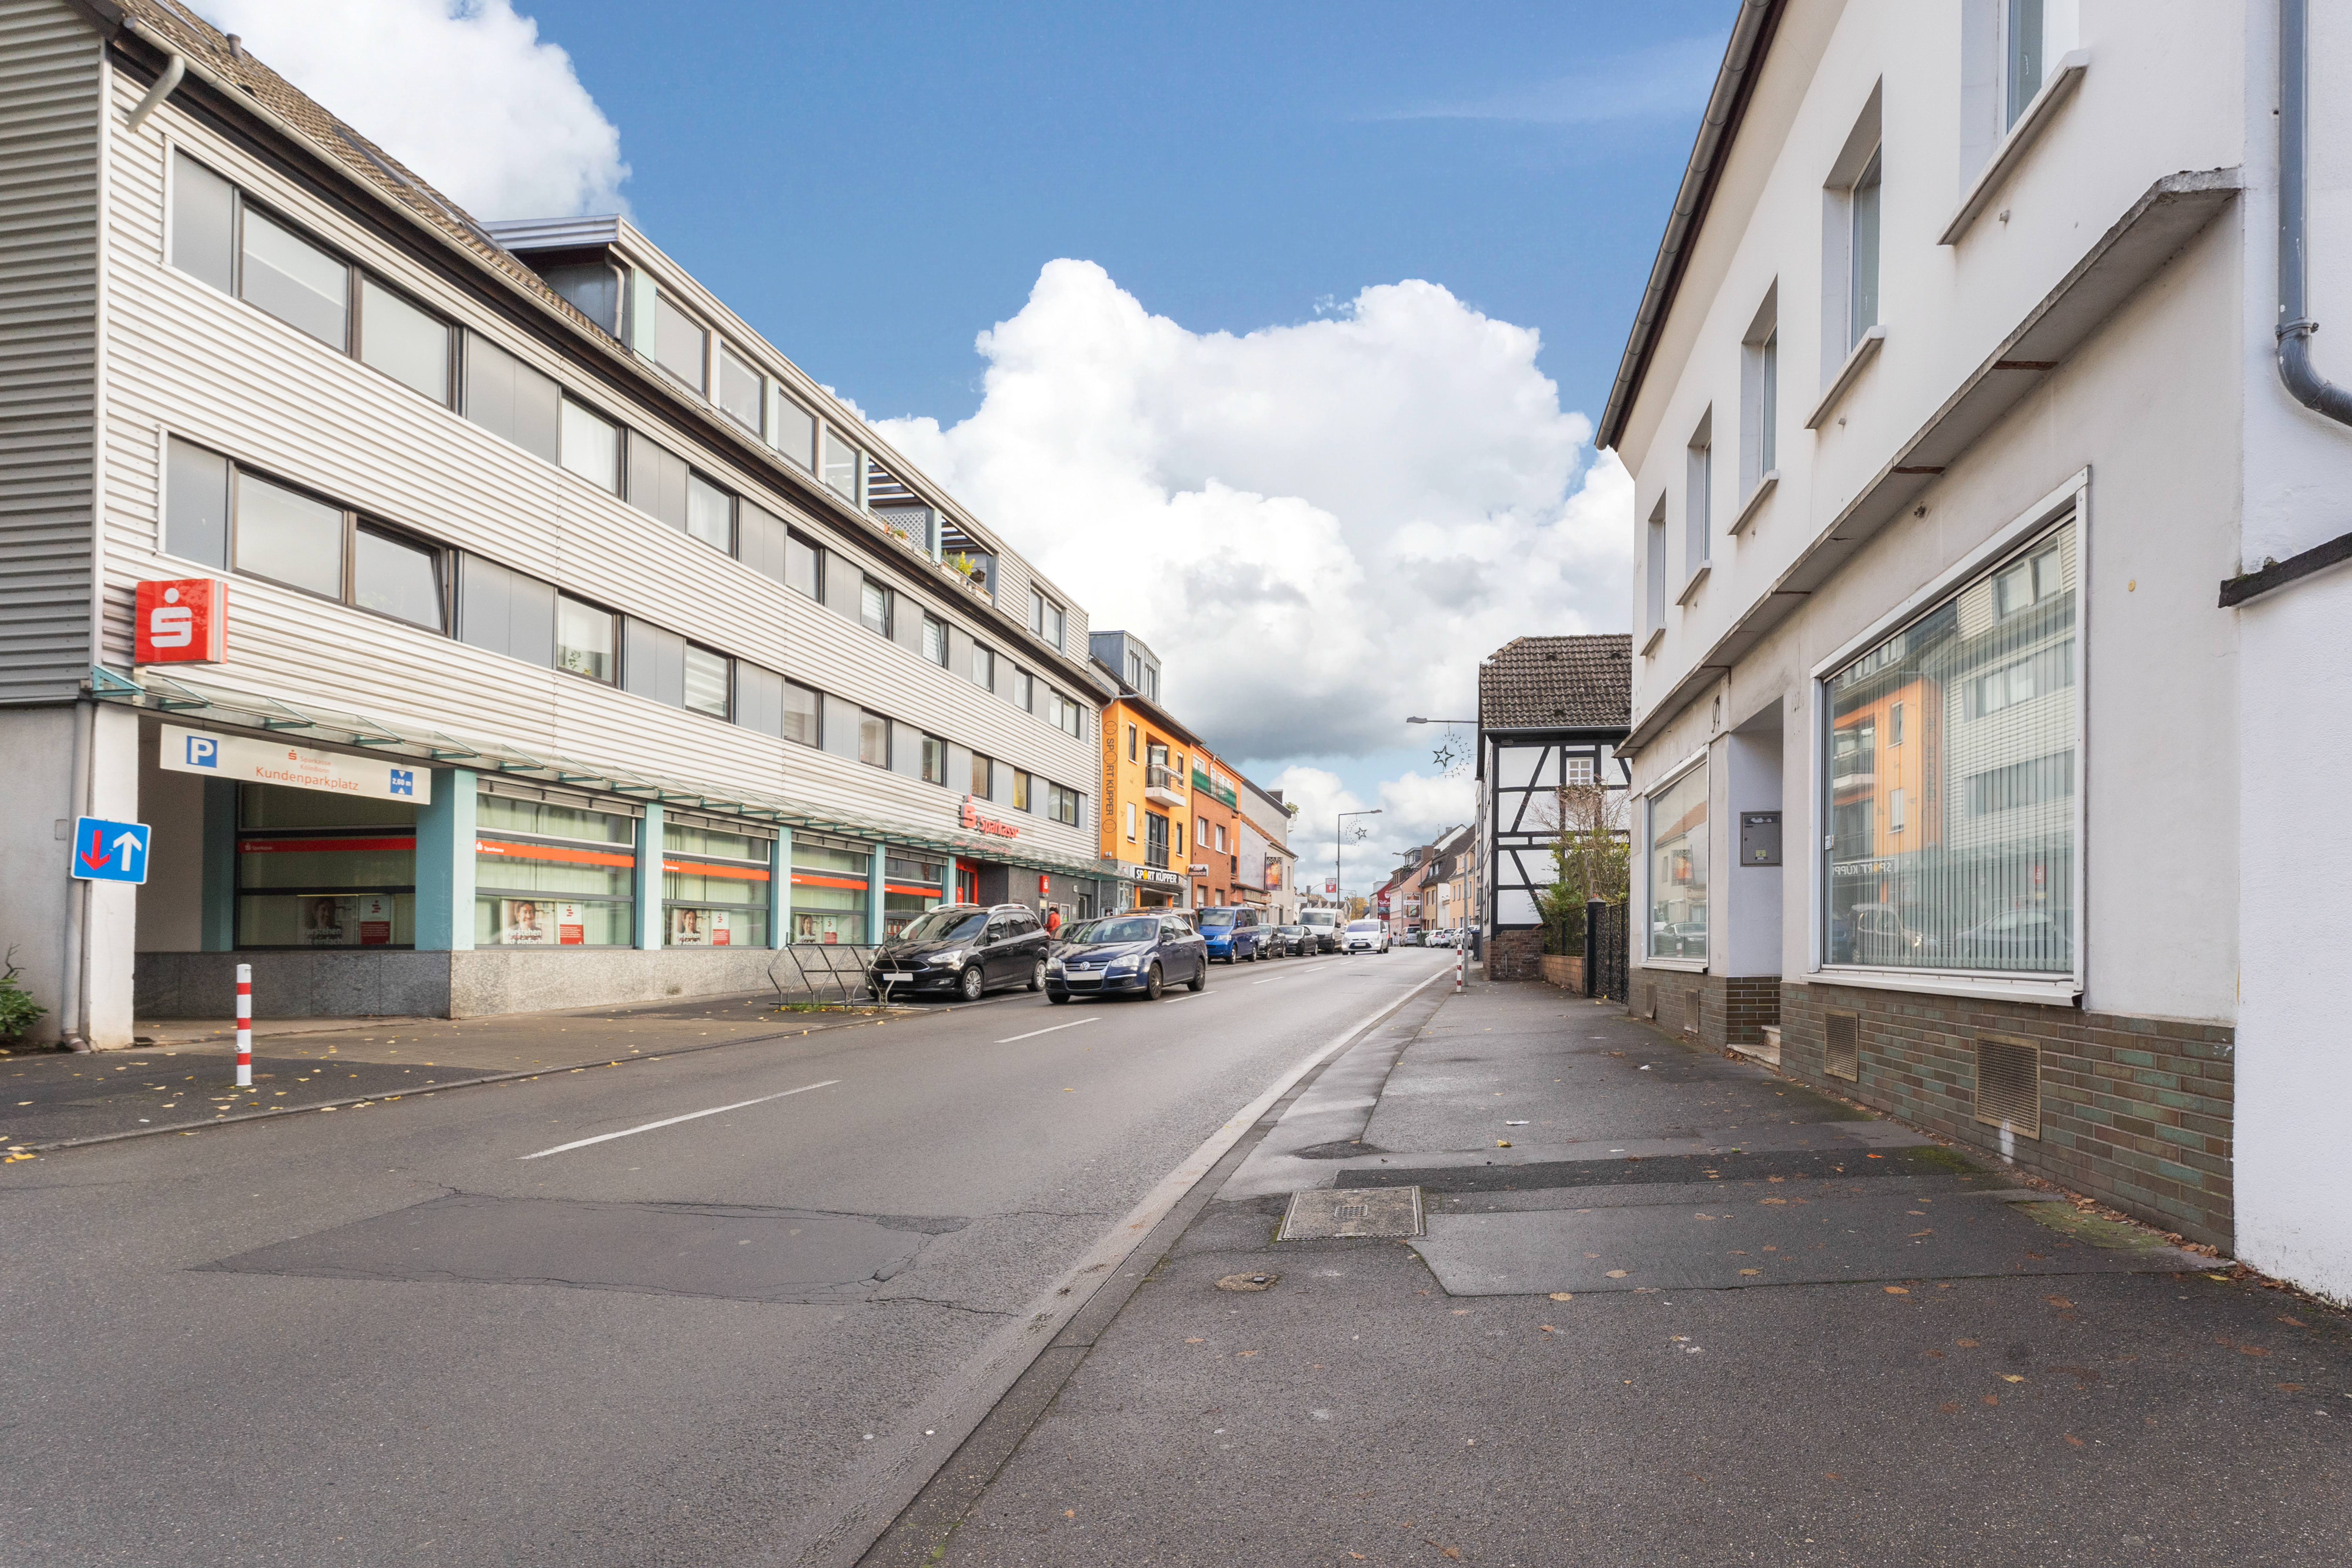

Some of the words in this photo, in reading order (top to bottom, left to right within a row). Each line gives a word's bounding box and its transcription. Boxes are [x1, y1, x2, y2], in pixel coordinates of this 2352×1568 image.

[190, 738, 214, 764] P
[300, 756, 331, 766] Sparkasse
[300, 764, 330, 773] KölnBonn
[256, 767, 358, 791] Kundenparkplatz
[392, 778, 405, 786] 2,60
[1106, 780, 1115, 816] KÜPPER
[980, 815, 1019, 838] Sparkasse
[1136, 869, 1155, 880] SPORT
[1156, 871, 1177, 883] KÜPPER
